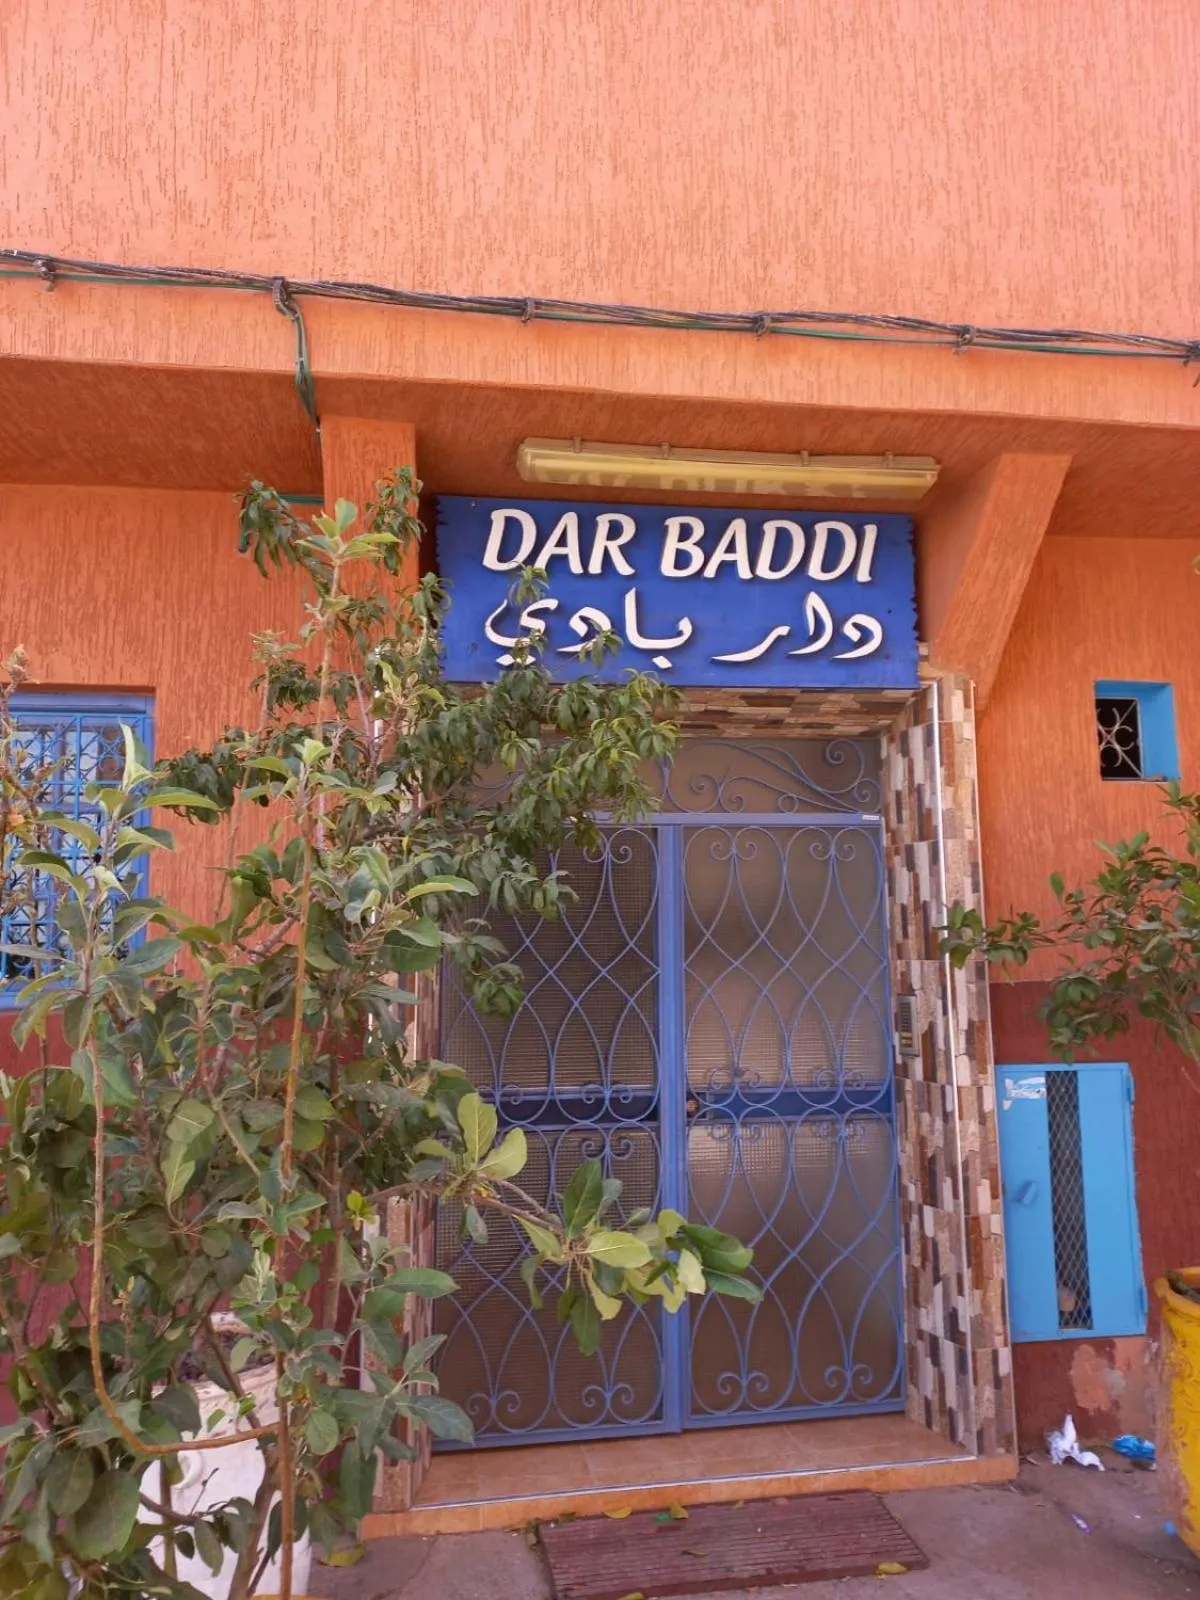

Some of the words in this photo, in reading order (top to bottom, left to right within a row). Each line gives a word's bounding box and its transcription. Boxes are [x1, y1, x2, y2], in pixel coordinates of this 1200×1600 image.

[482, 508, 636, 576] DAR
[660, 516, 878, 583] BADDI
[484, 587, 693, 669] بادي
[711, 591, 883, 662] دار
